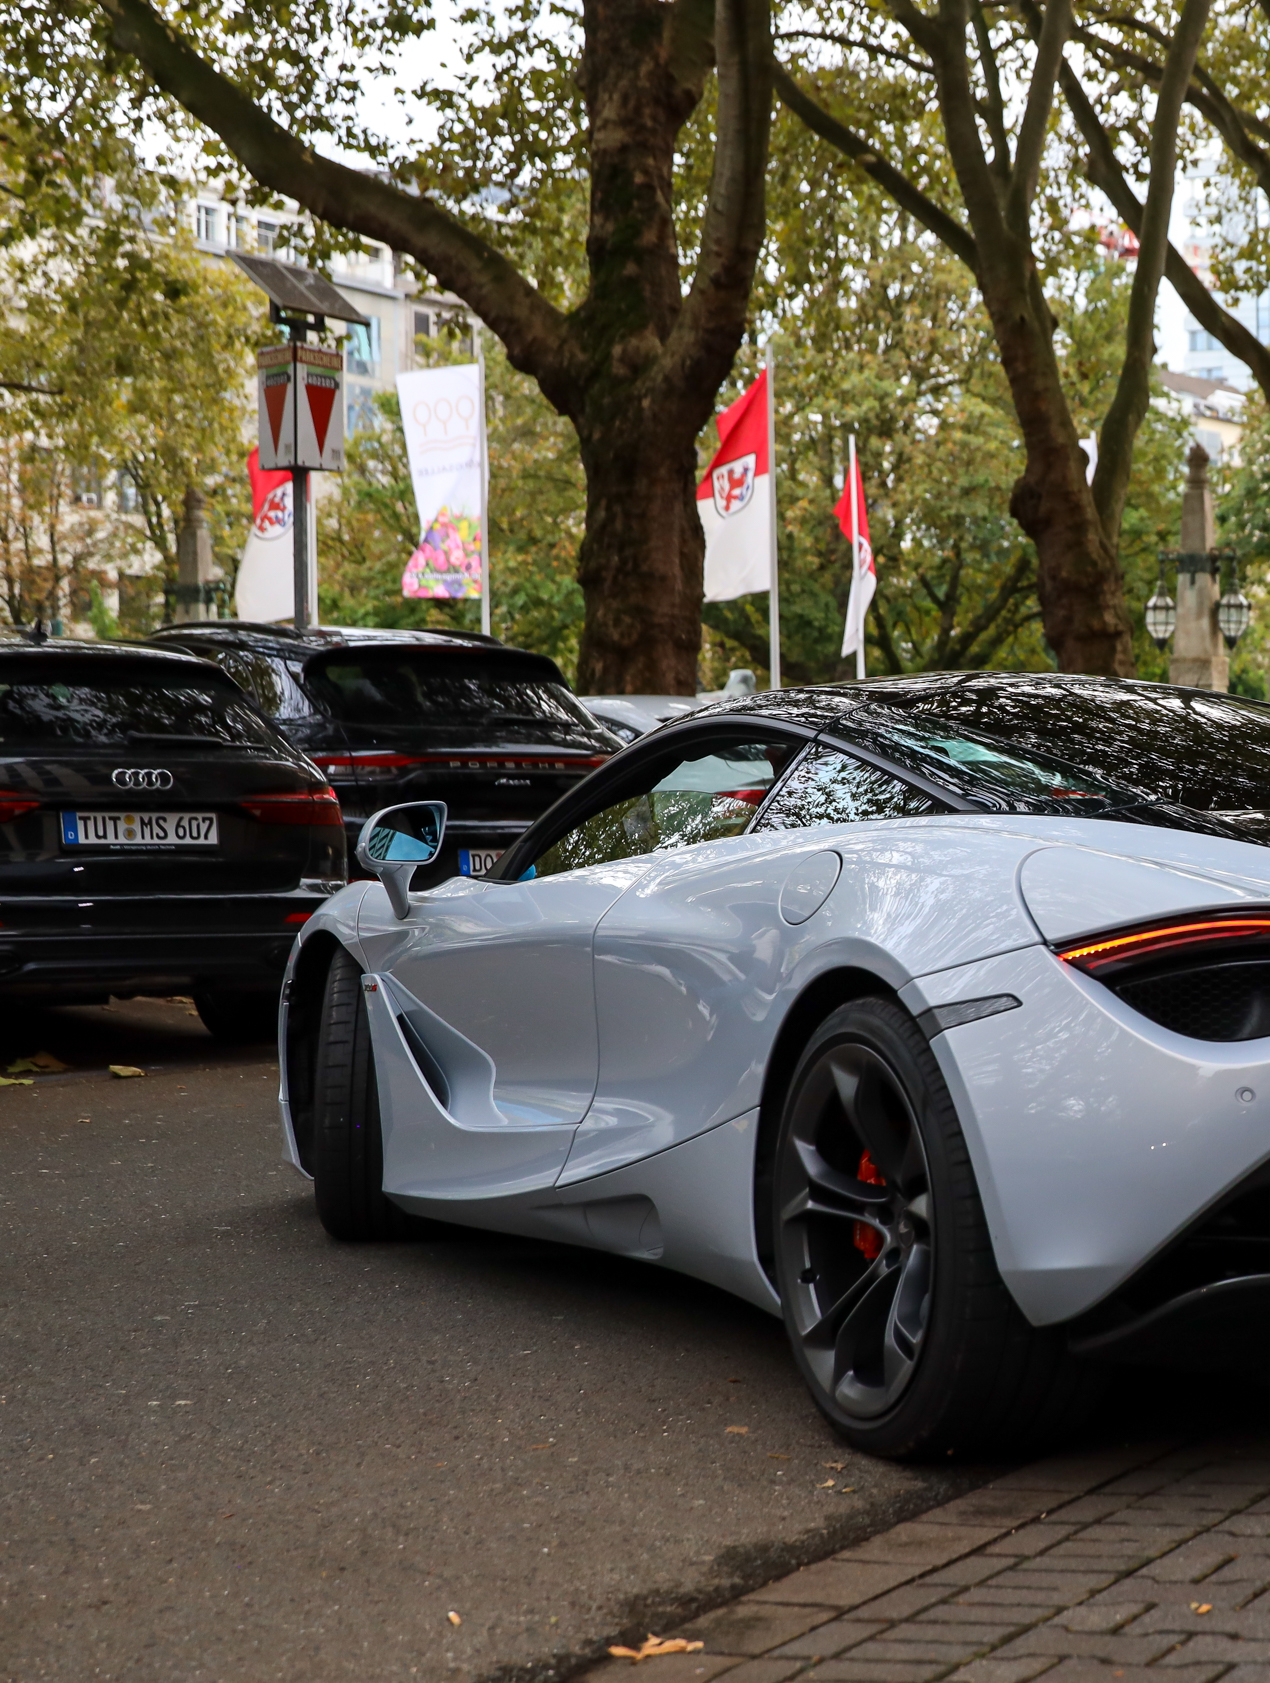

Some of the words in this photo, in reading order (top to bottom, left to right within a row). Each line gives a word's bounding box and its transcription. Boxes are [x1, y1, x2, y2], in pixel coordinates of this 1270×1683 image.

[78, 815, 122, 841] TUT
[140, 815, 168, 841] MS
[175, 815, 215, 841] 607
